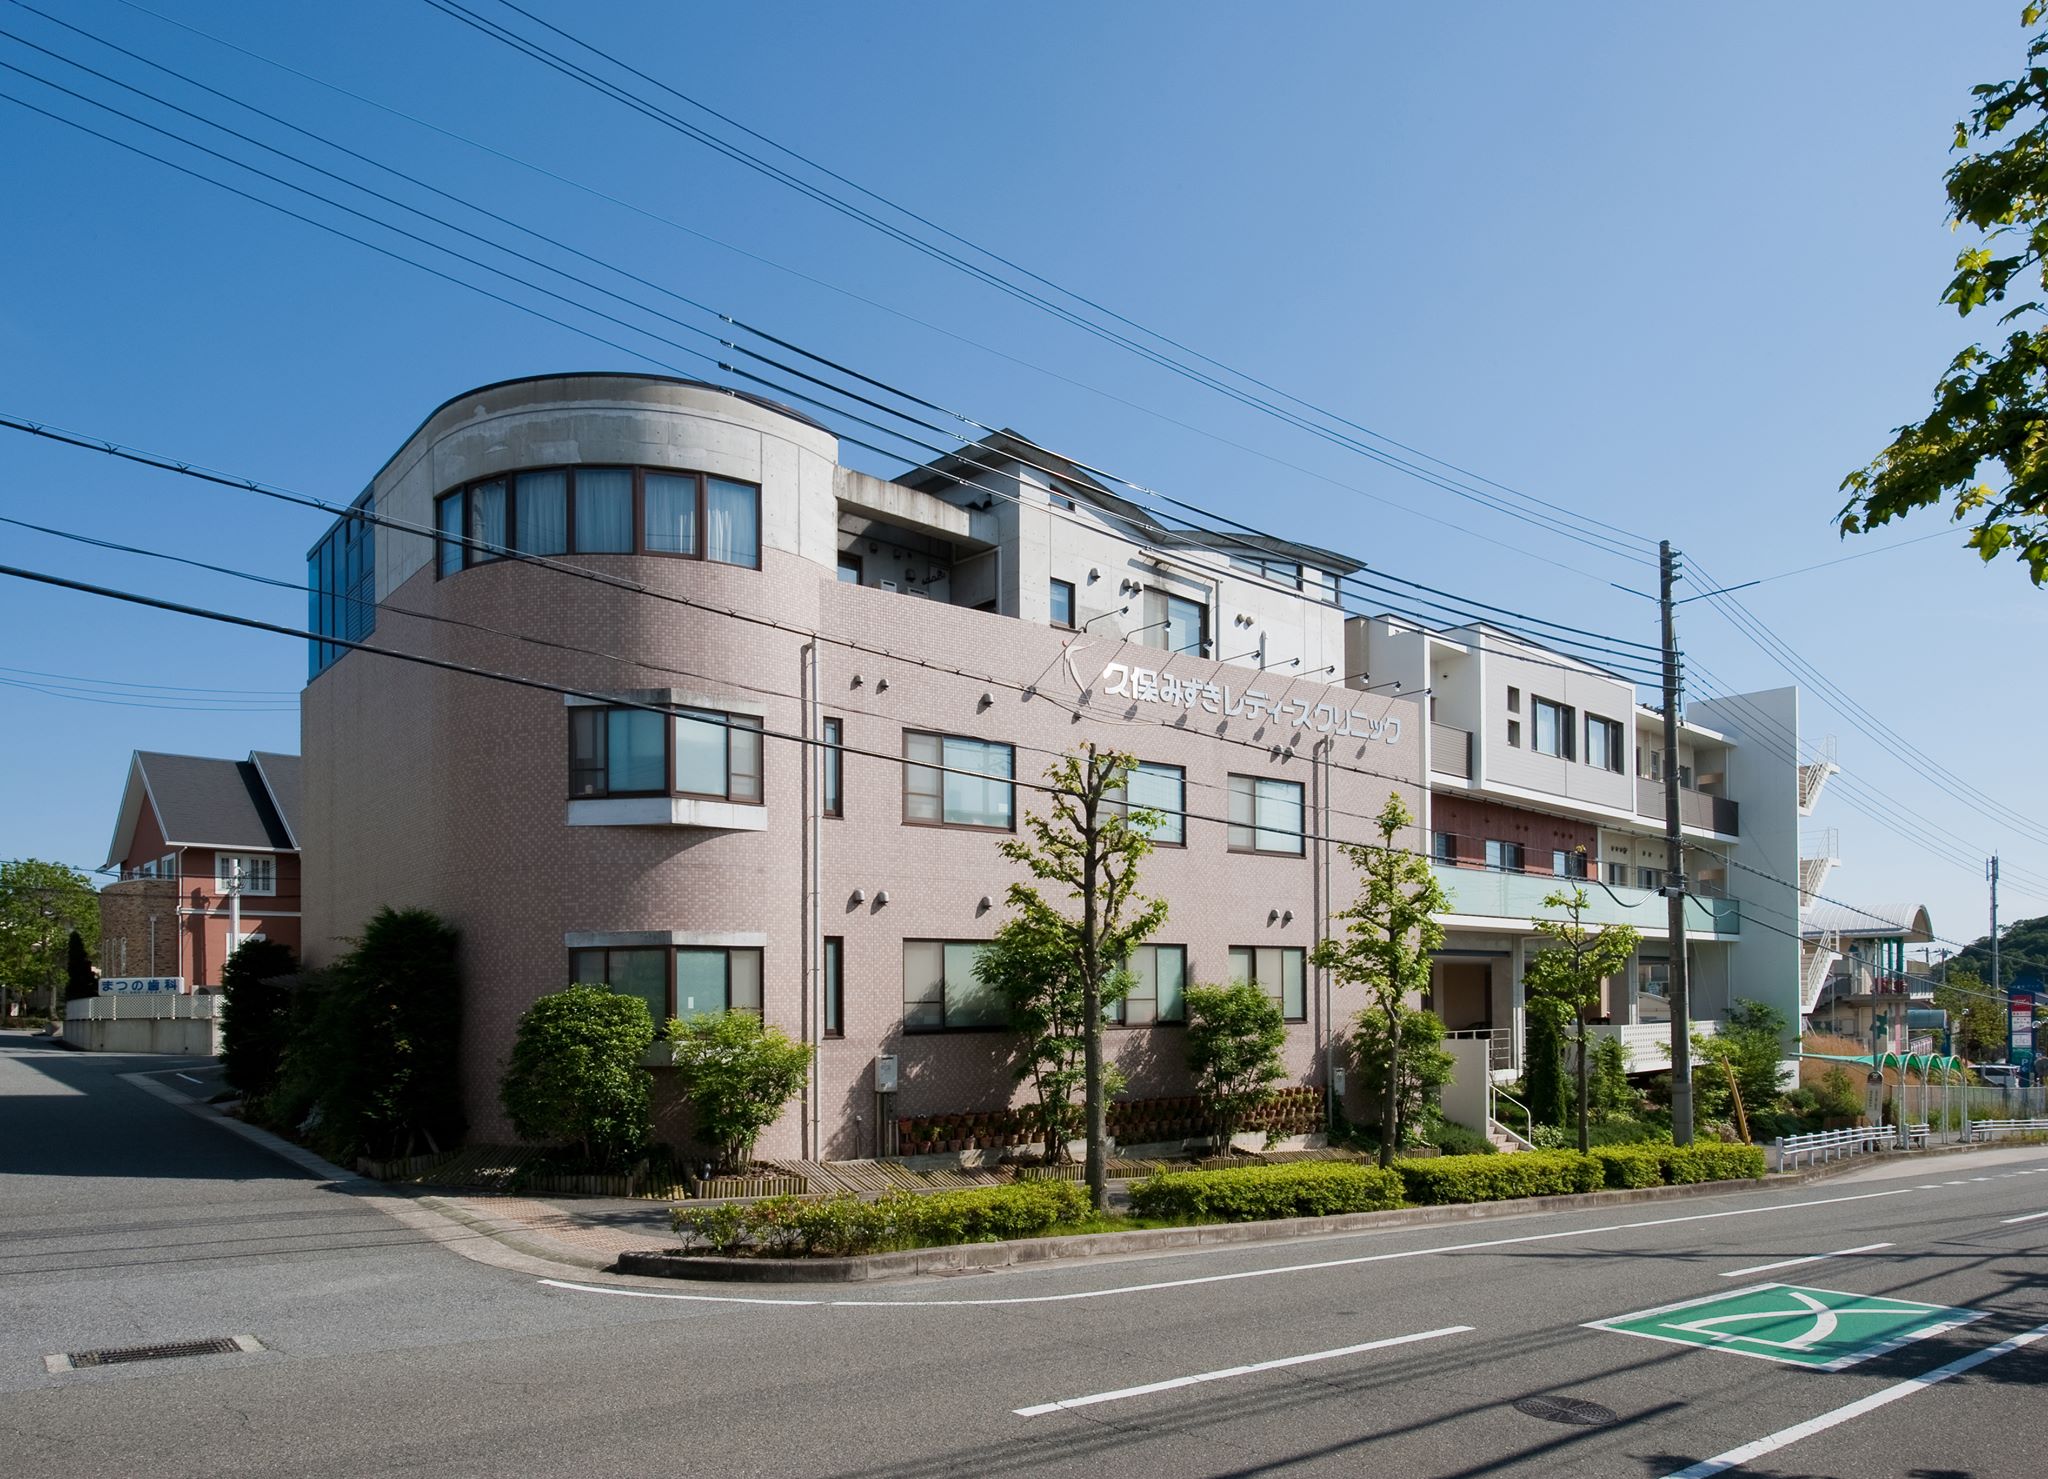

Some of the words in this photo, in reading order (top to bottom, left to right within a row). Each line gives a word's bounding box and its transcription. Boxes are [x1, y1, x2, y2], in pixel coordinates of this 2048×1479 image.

[1102, 662, 1401, 744] 久保みずきレディースクリニック
[102, 979, 177, 991] まつの歯科
[2021, 1058, 2029, 1066] P
